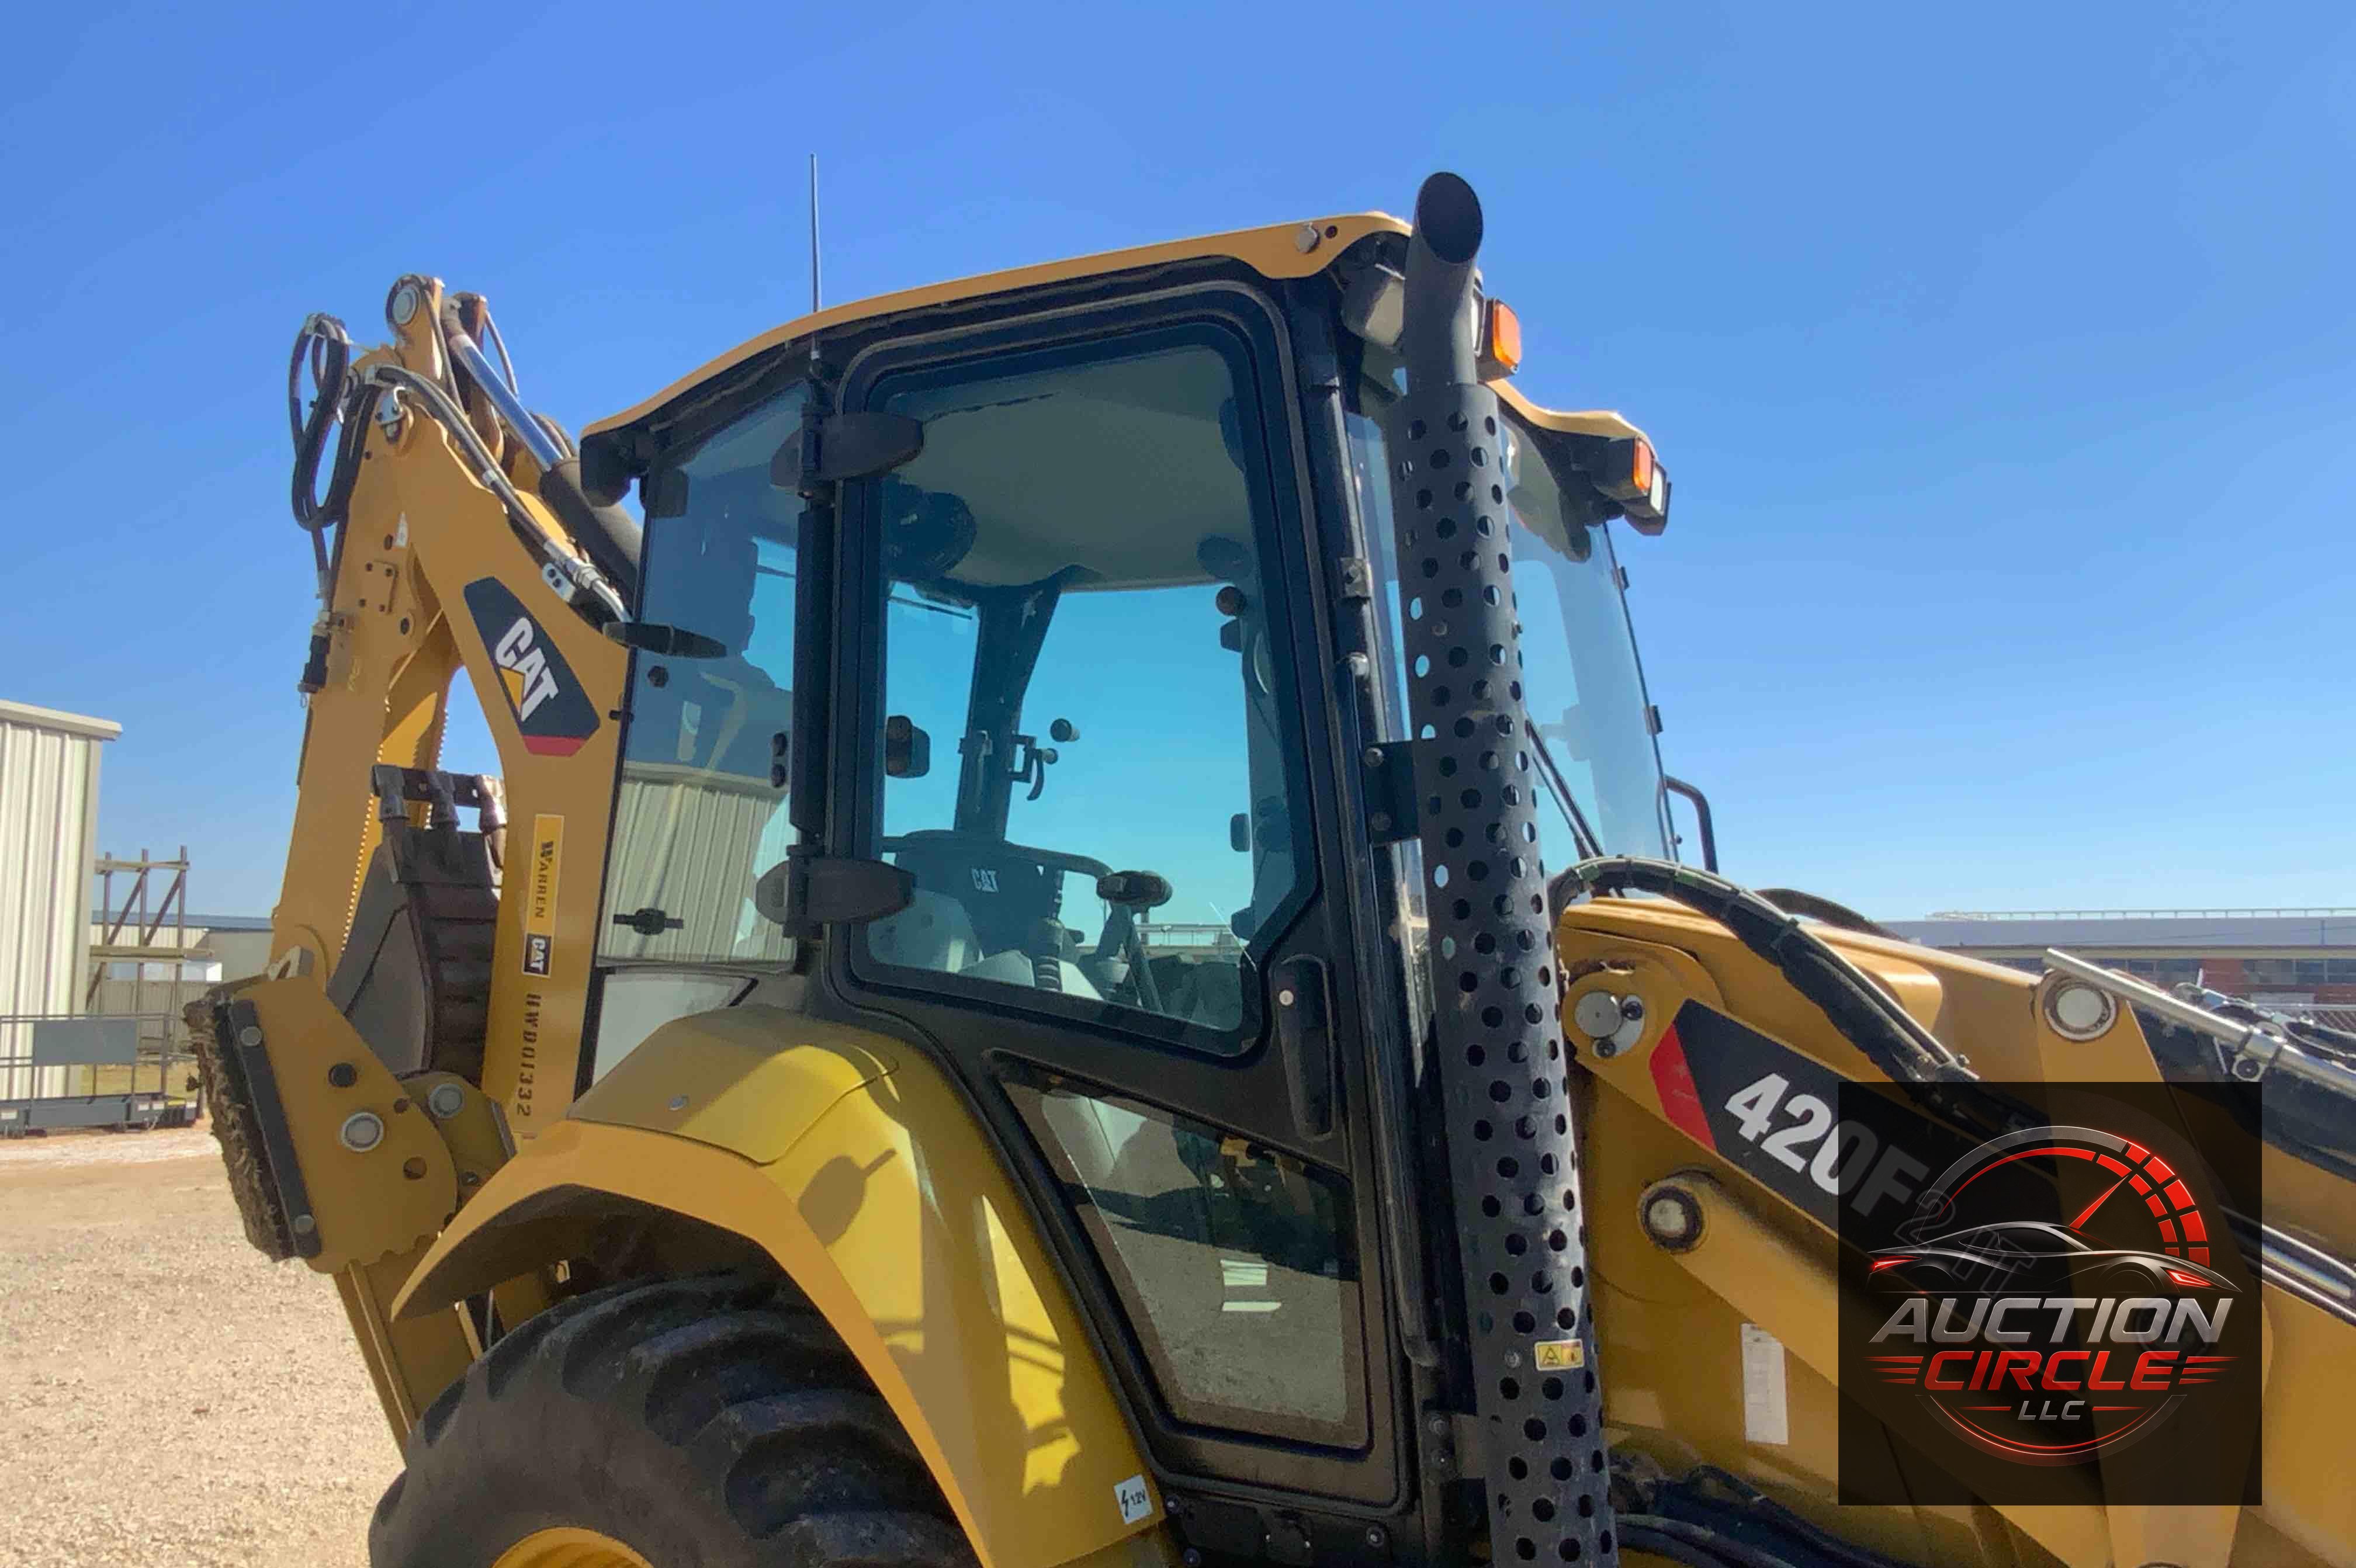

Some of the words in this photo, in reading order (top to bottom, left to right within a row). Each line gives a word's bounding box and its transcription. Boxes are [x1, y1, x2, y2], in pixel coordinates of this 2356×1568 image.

[496, 617, 559, 722] CAT
[535, 840, 554, 919] WARREN
[972, 869, 999, 893] CAT
[529, 936, 548, 973] CAT
